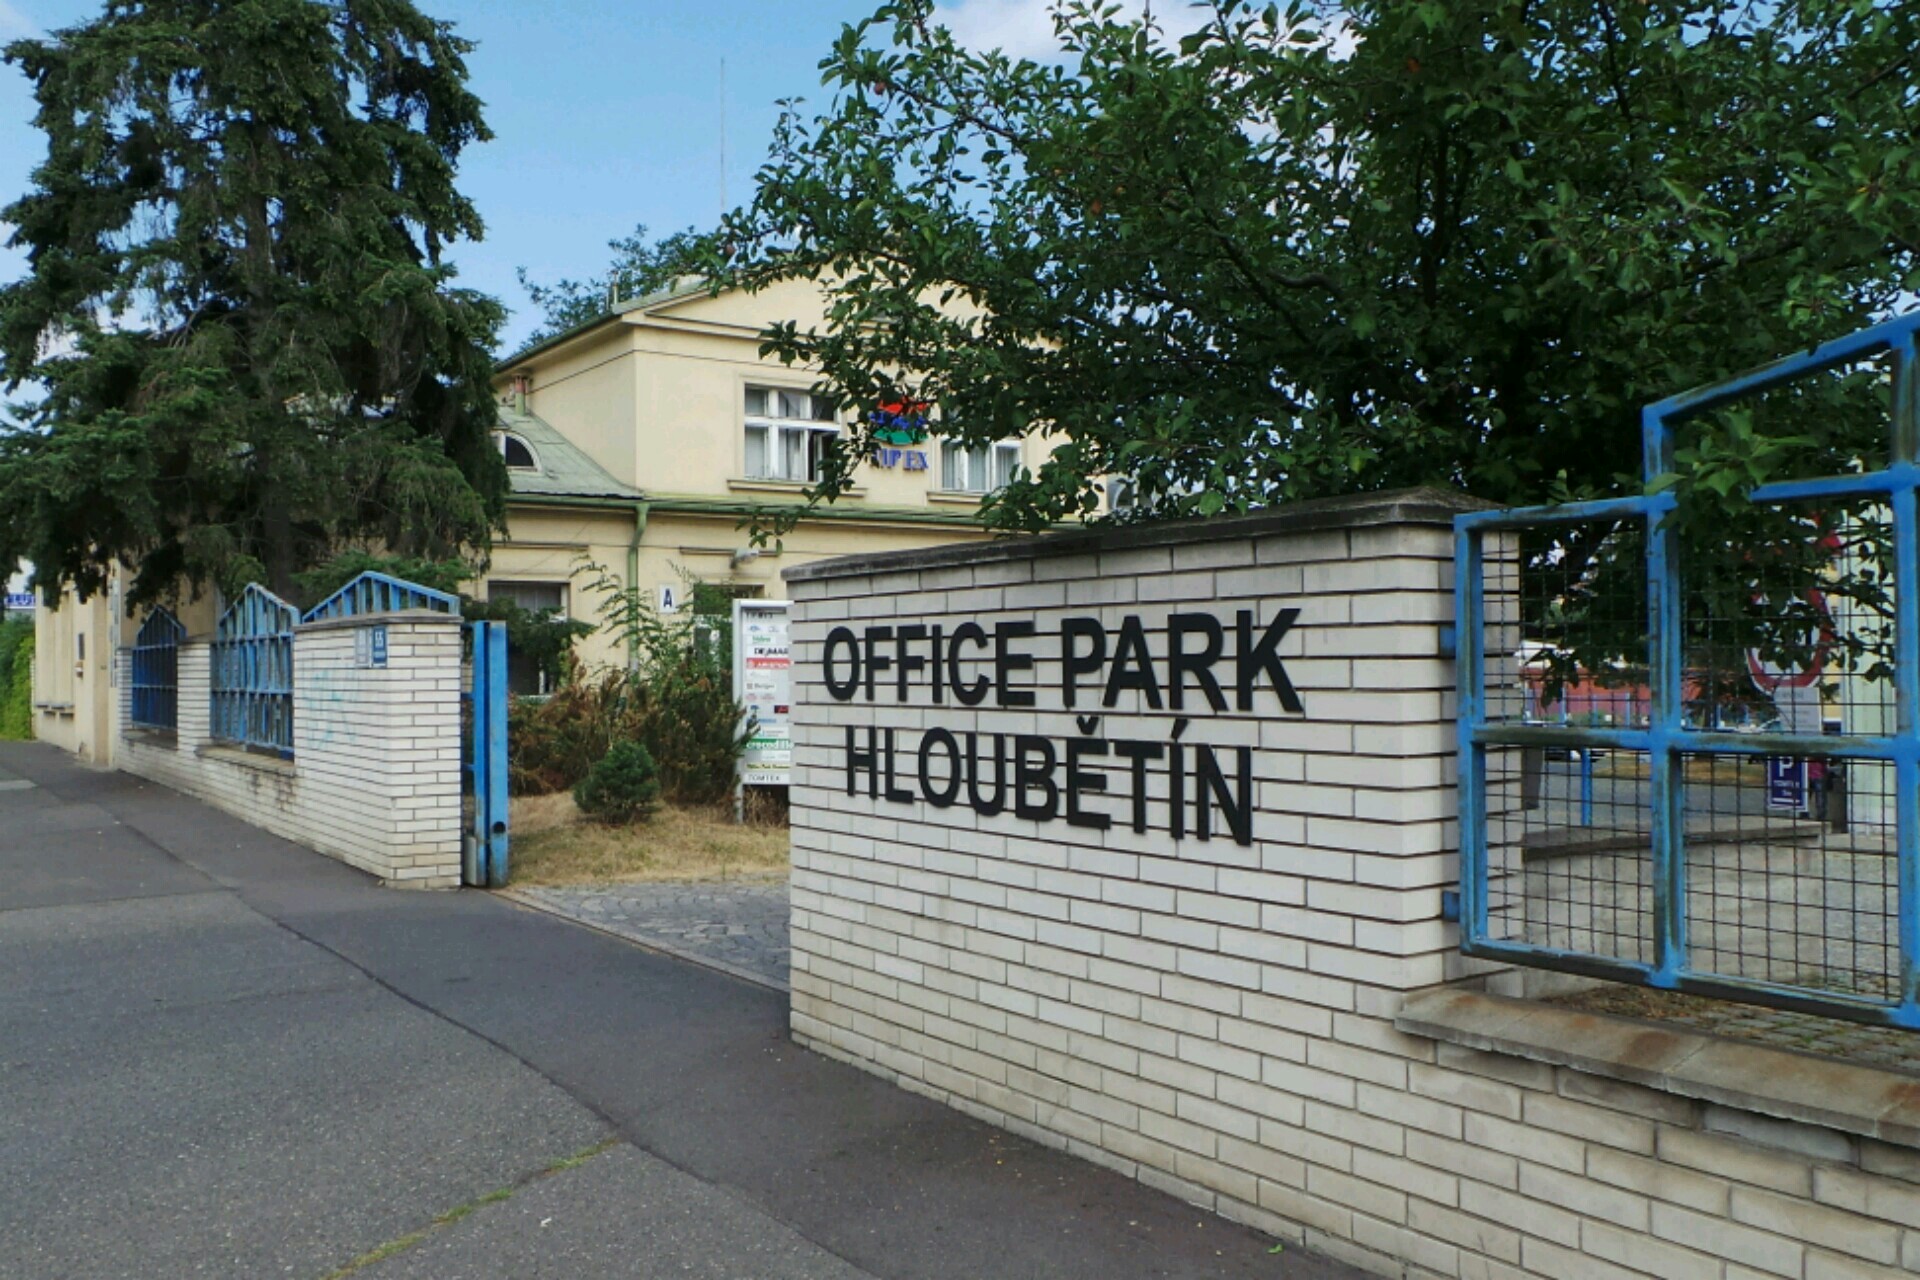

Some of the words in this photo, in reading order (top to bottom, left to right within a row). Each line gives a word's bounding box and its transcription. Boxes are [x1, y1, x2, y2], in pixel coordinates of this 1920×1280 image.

[663, 588, 673, 608] A
[823, 621, 1037, 707] OFFICE
[1061, 608, 1305, 713] PARK
[846, 716, 1252, 847] HLOUBĚTÍN
[1778, 756, 1794, 777] P
